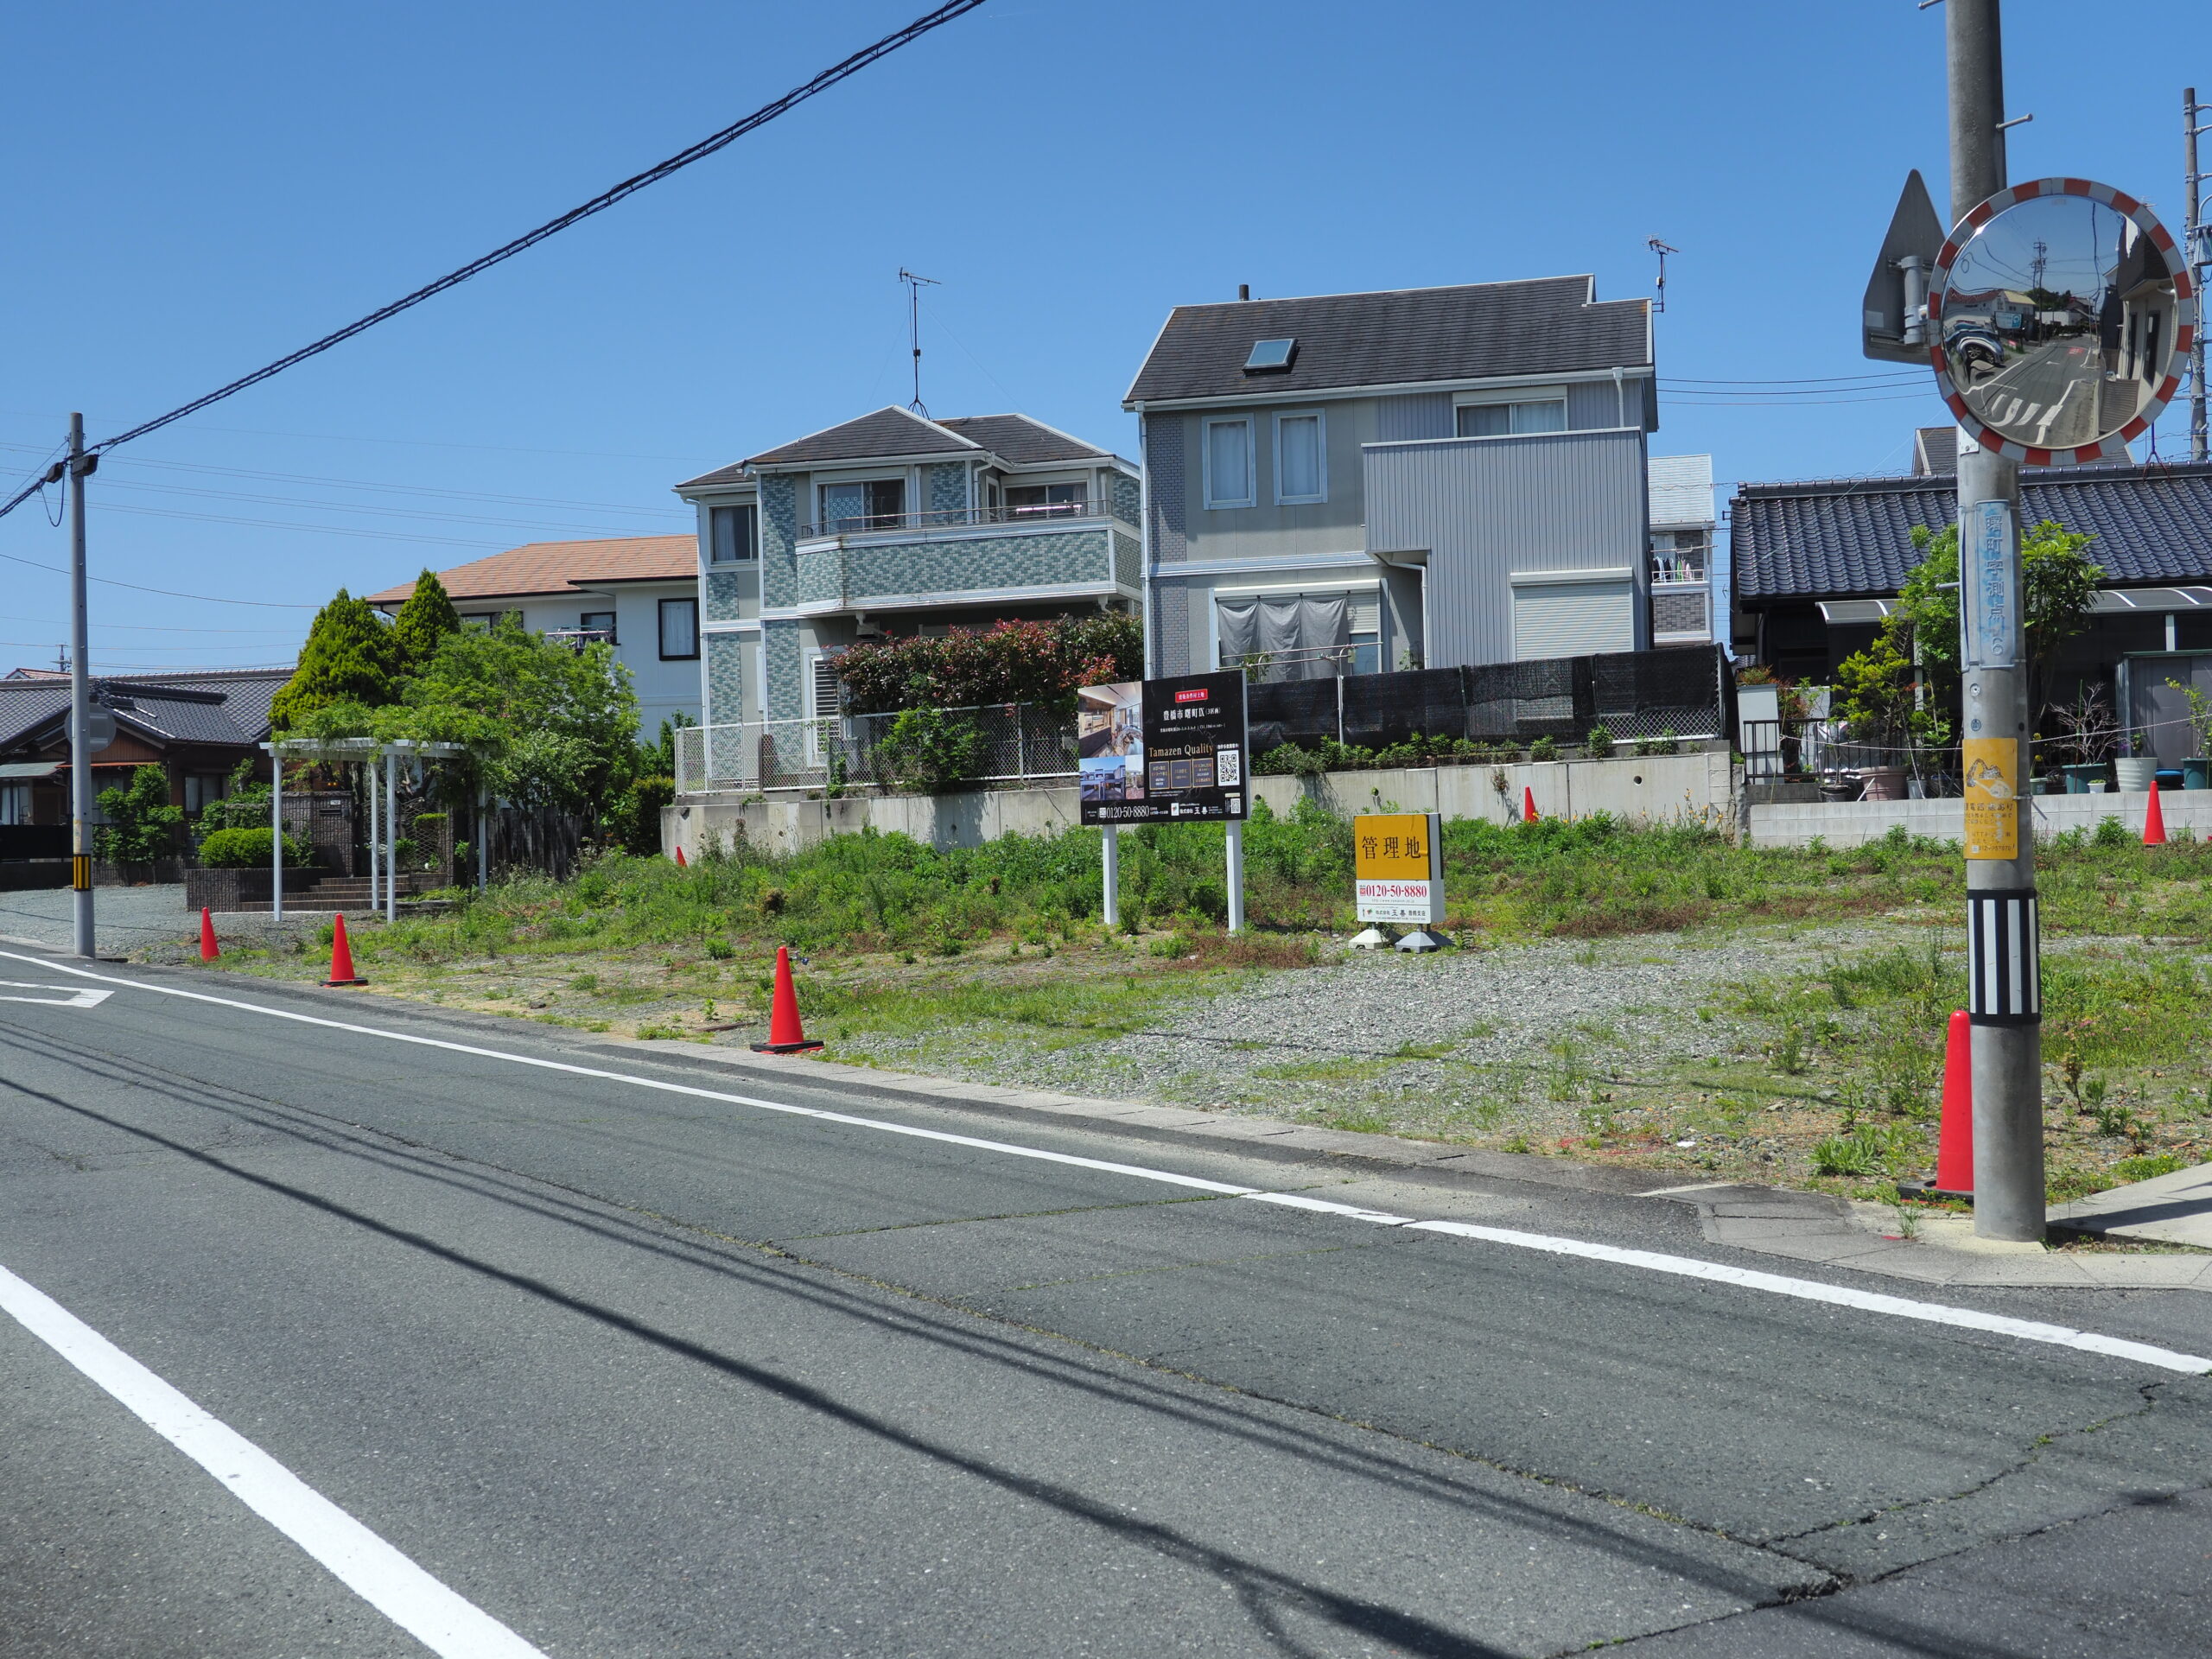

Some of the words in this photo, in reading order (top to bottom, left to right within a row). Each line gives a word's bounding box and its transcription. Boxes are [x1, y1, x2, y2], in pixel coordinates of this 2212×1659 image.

[1148, 747, 1182, 758] Tamazen
[1184, 743, 1213, 756] Quality
[1106, 804, 1150, 818] 0120-50-8880
[1362, 836, 1421, 860] 管理地
[1366, 885, 1427, 898] 0120-50-8880
